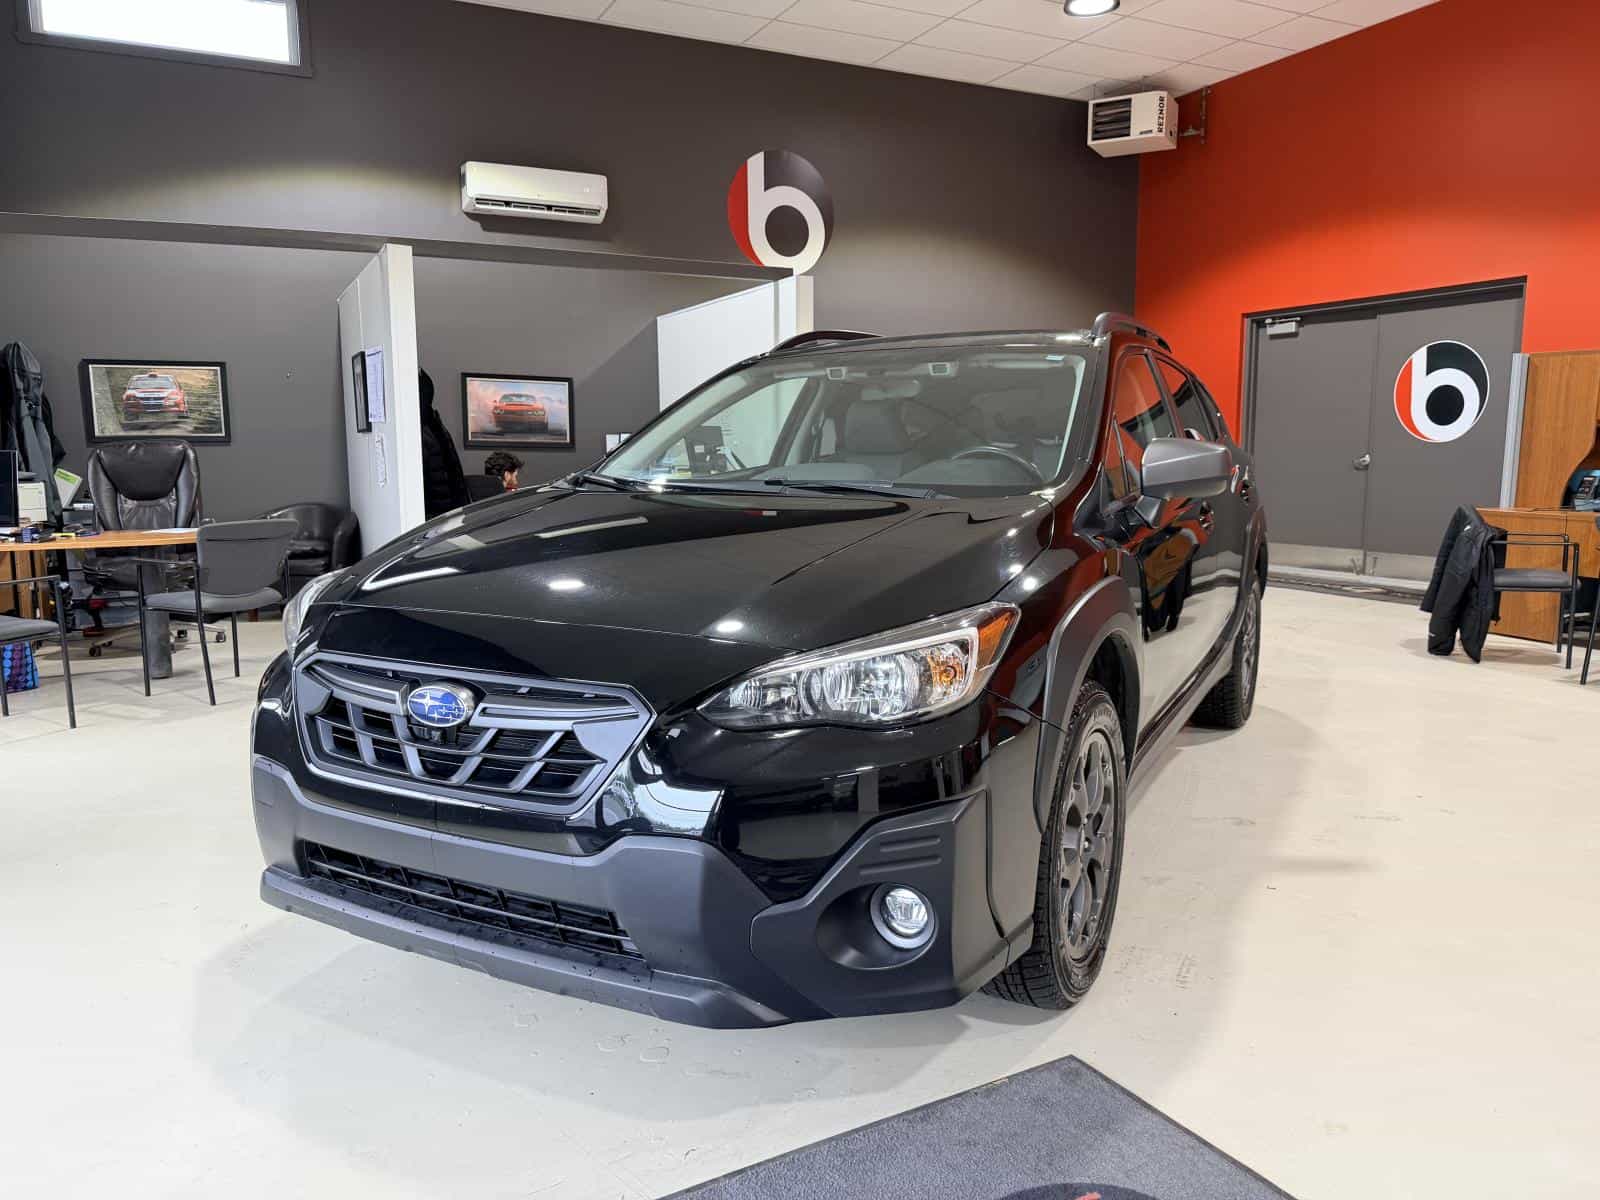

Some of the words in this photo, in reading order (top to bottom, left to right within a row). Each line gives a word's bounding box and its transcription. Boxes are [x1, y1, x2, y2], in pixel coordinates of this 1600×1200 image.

[1157, 95, 1165, 133] REZNOR
[747, 151, 826, 275] b
[1410, 344, 1480, 442] b
